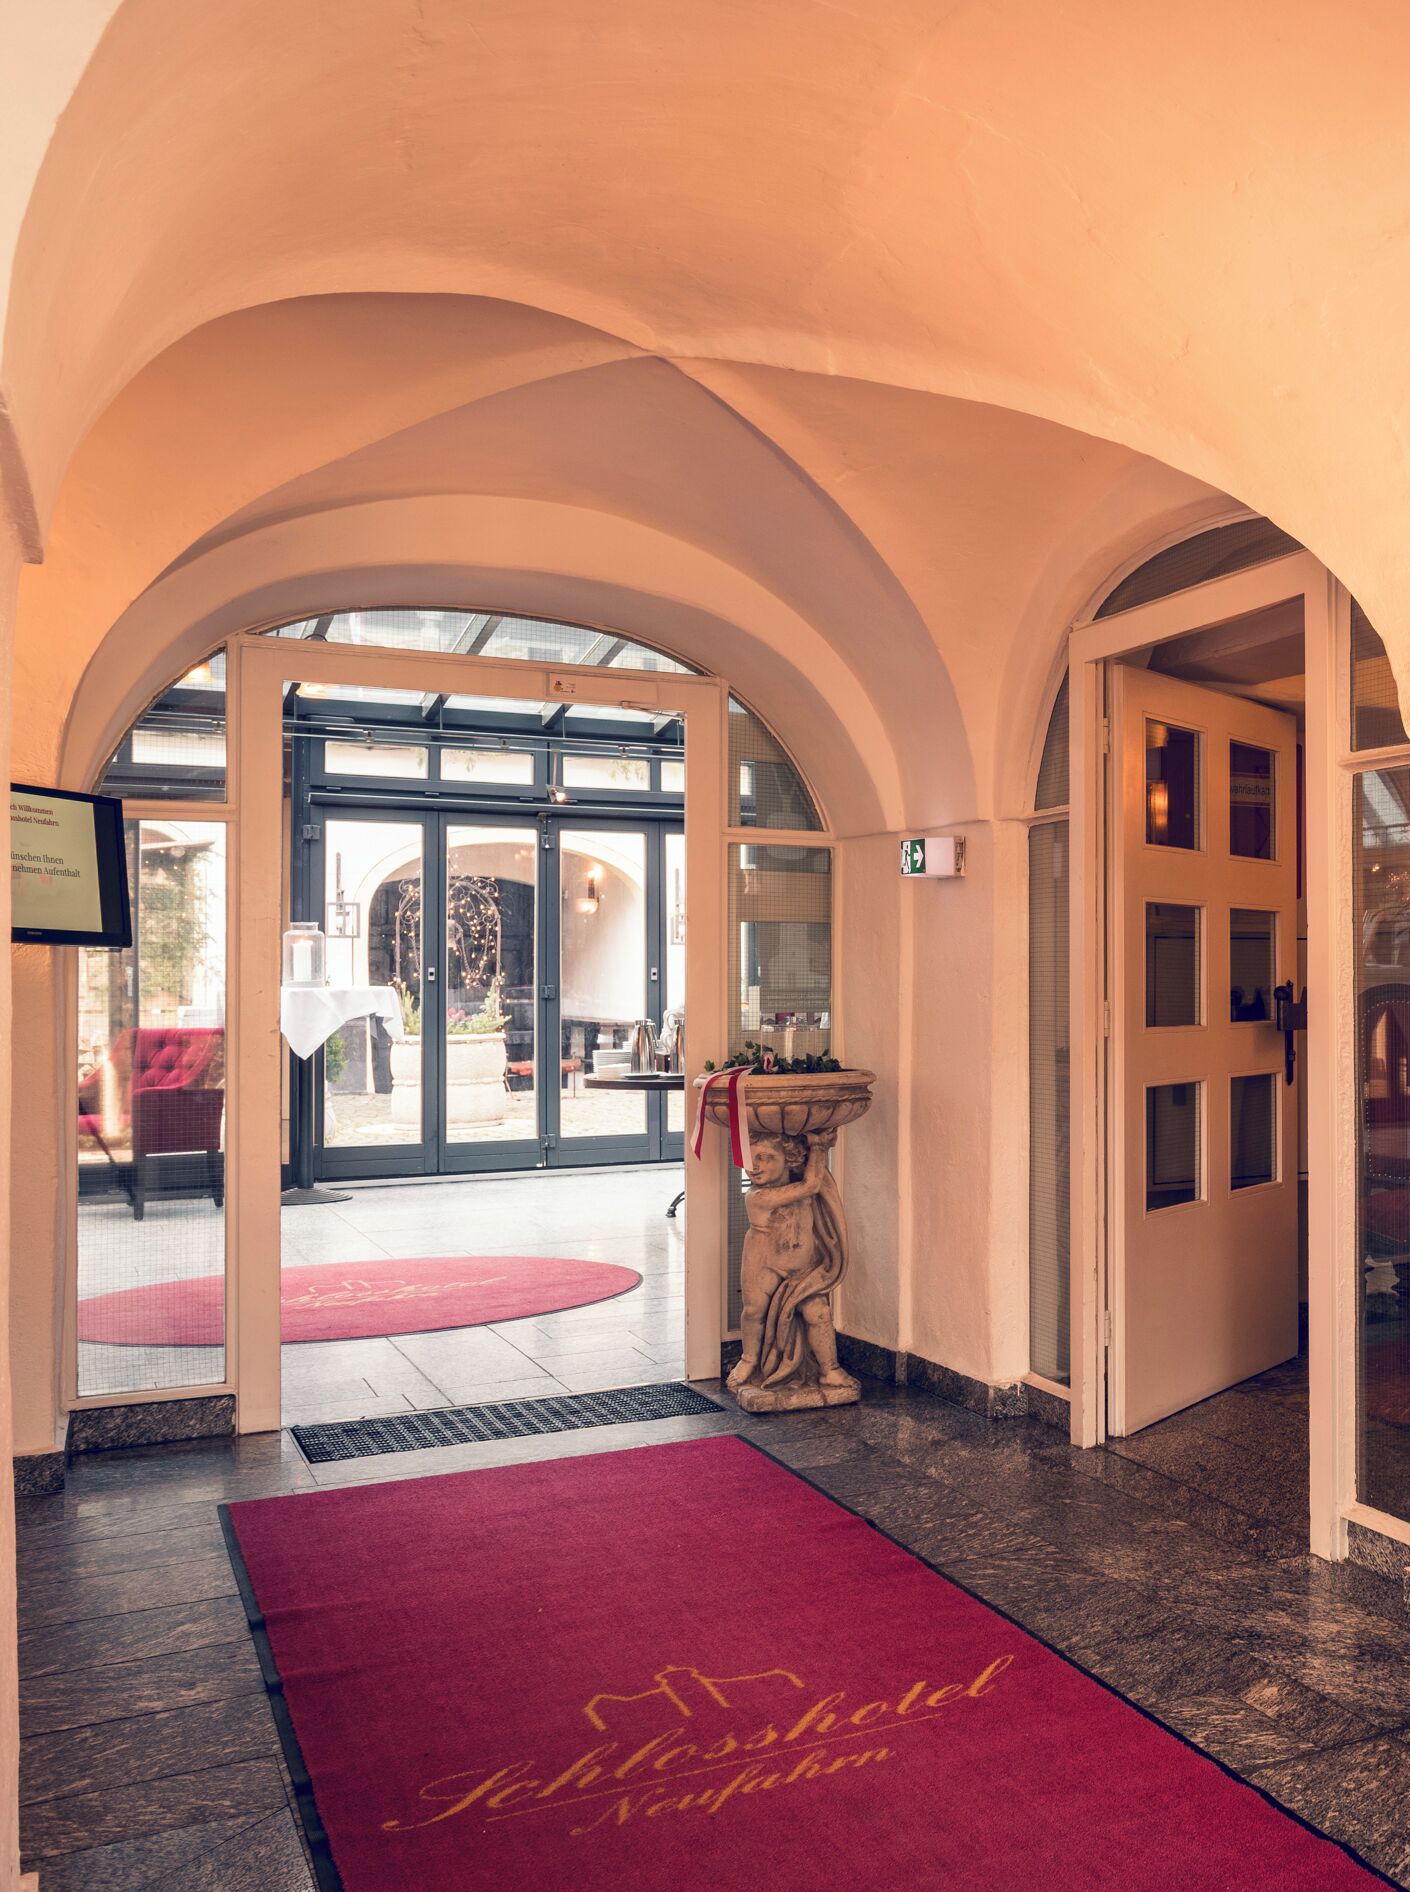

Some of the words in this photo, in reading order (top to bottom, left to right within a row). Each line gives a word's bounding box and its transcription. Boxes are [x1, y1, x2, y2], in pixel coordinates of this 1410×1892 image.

[18, 804, 53, 815] Willkommen
[33, 817, 59, 827] Neufahrn
[42, 854, 64, 865] Ihnen
[44, 867, 80, 878] Aufenthalt
[382, 1654, 1015, 1831] Schlosshotel
[569, 1745, 896, 1837] Neufahrn
